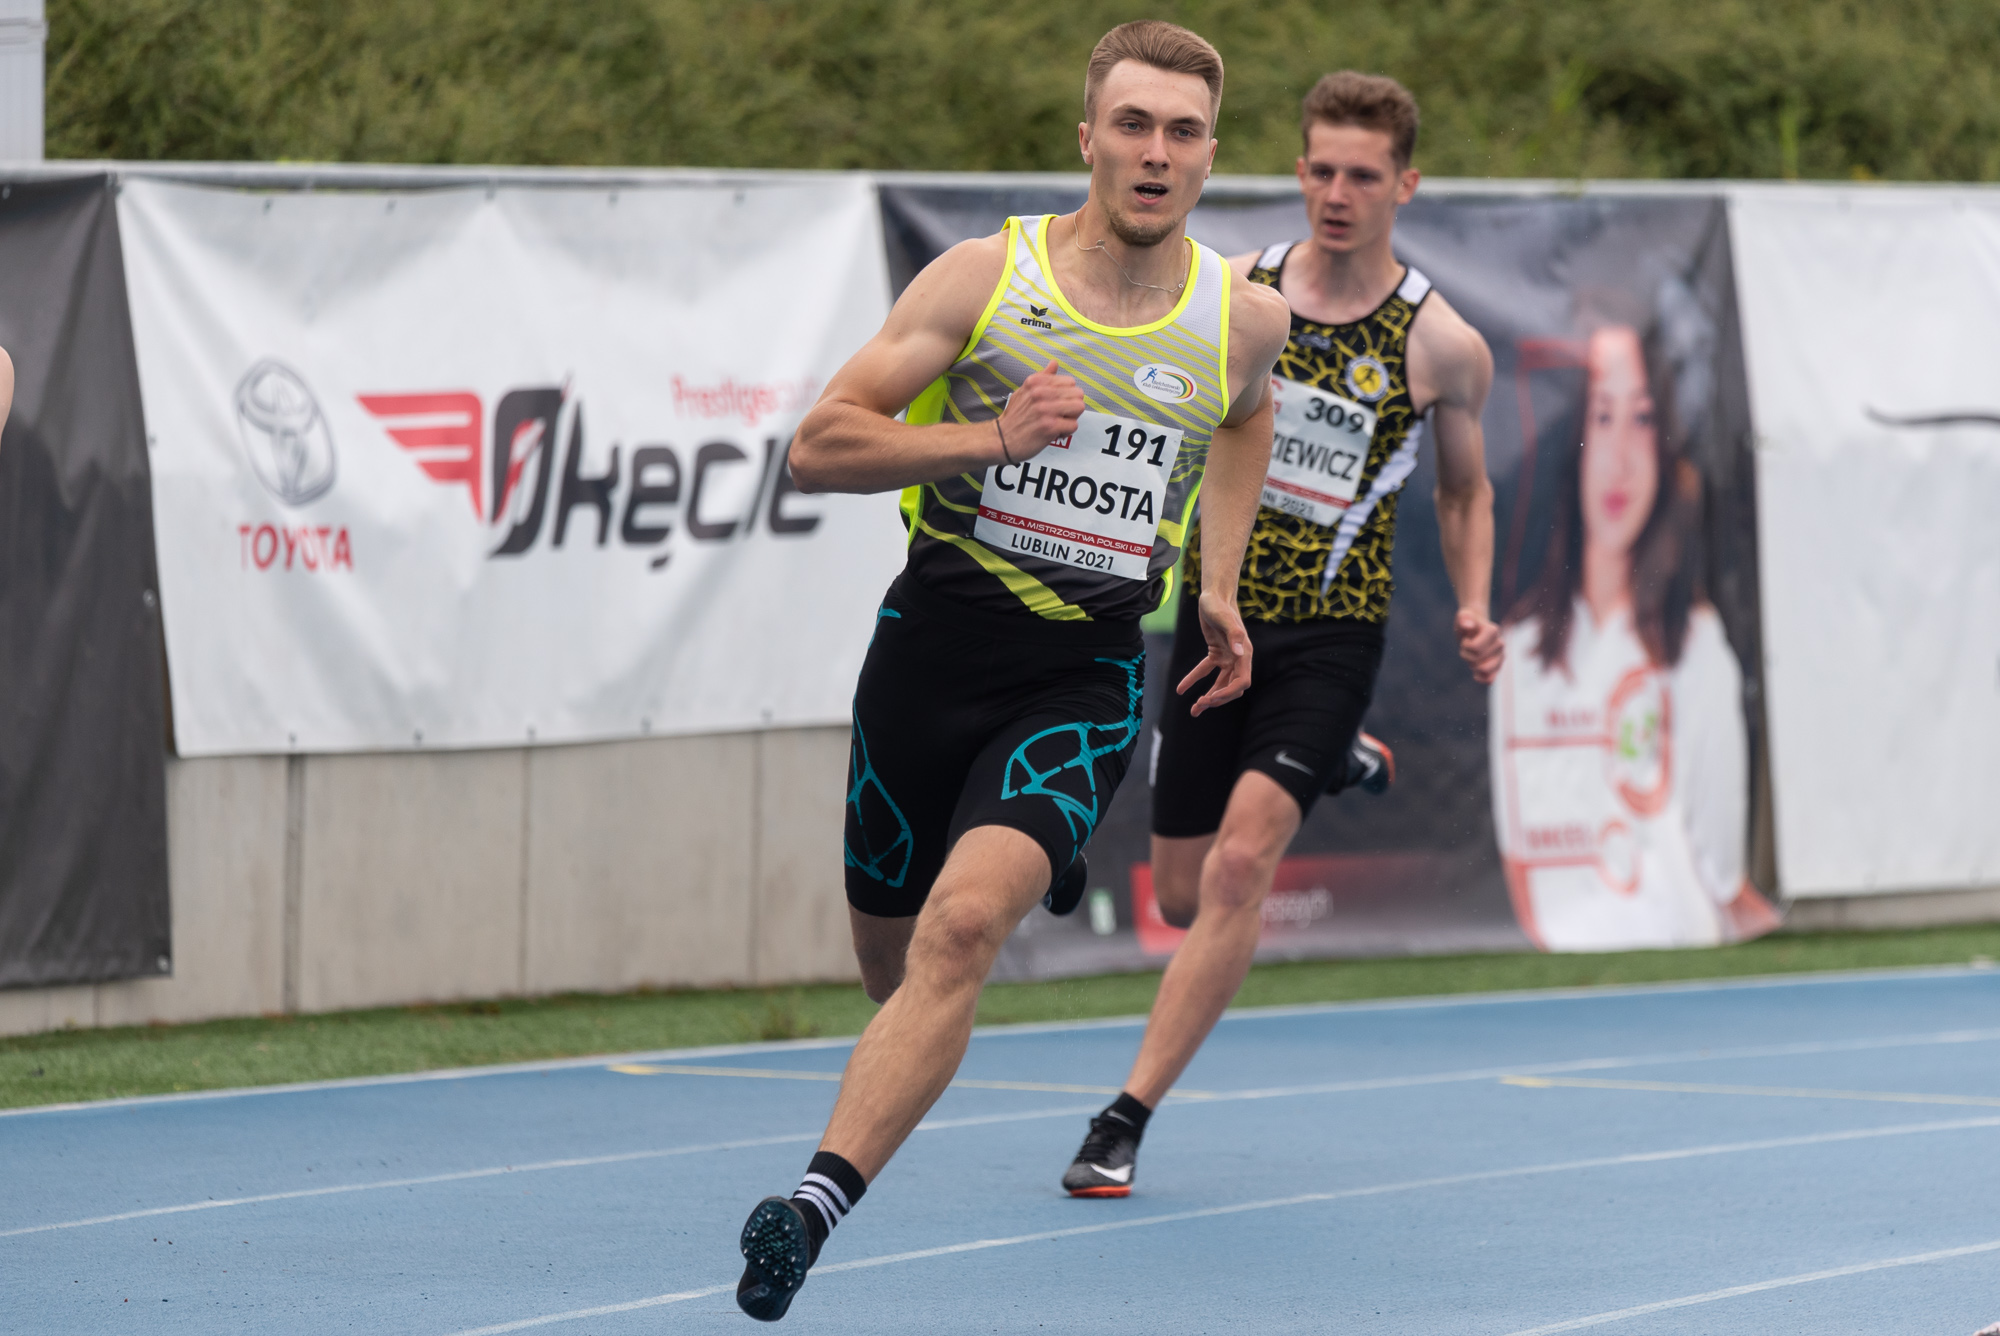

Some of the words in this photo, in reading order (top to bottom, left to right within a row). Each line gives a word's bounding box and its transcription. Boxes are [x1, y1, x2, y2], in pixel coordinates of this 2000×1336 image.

[1021, 317, 1052, 330] erima
[1304, 396, 1365, 434] 309
[1101, 424, 1167, 467] 191
[995, 461, 1154, 525] CHROSTA
[238, 522, 353, 573] TOYOTA
[985, 509, 1000, 520] 75.
[1000, 514, 1026, 527] PZLA
[1026, 521, 1095, 544] MISTRZOSTWA
[1096, 537, 1129, 551] POLSKI
[1129, 545, 1148, 555] U20
[1011, 533, 1071, 561] LUBLIN
[1073, 549, 1115, 571] 2021
